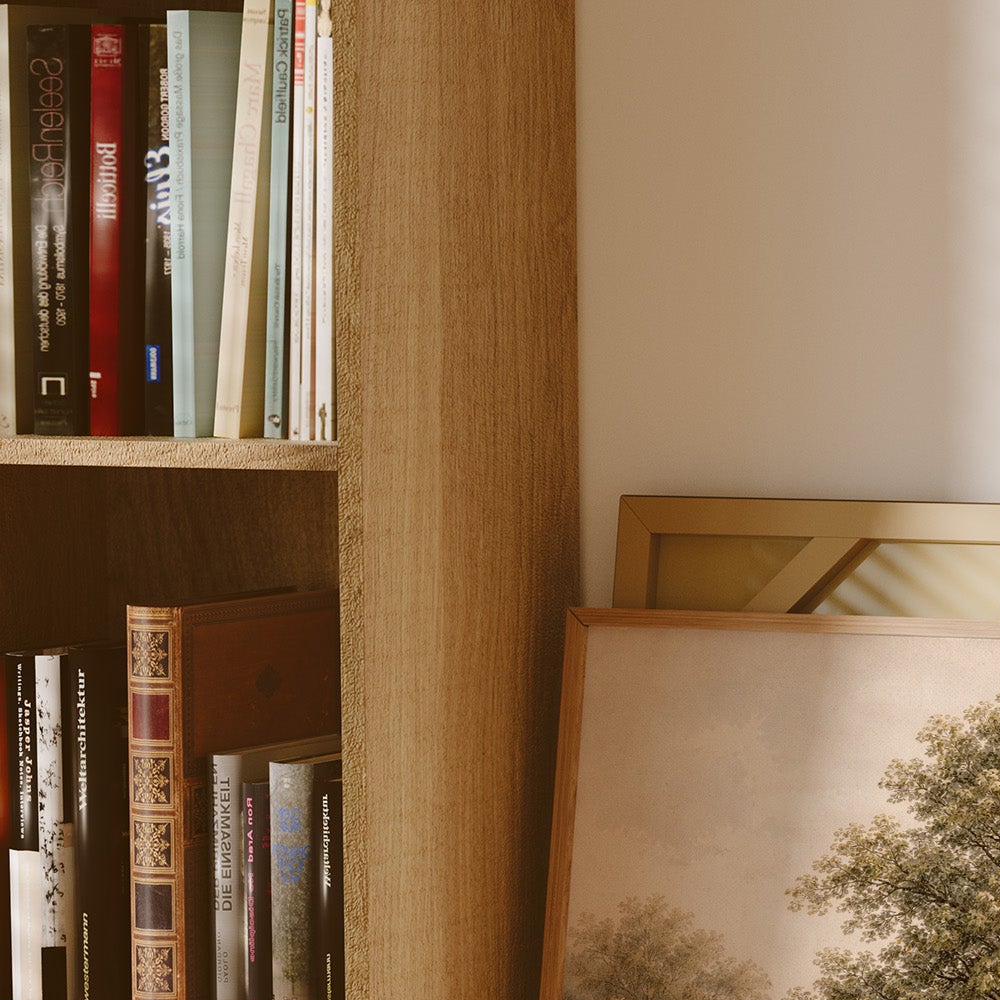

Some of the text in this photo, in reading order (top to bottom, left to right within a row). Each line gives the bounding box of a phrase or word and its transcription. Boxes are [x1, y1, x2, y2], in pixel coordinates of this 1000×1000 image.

[23, 699, 33, 803] Jasper Johns
[77, 668, 88, 812] Weltarchitektur
